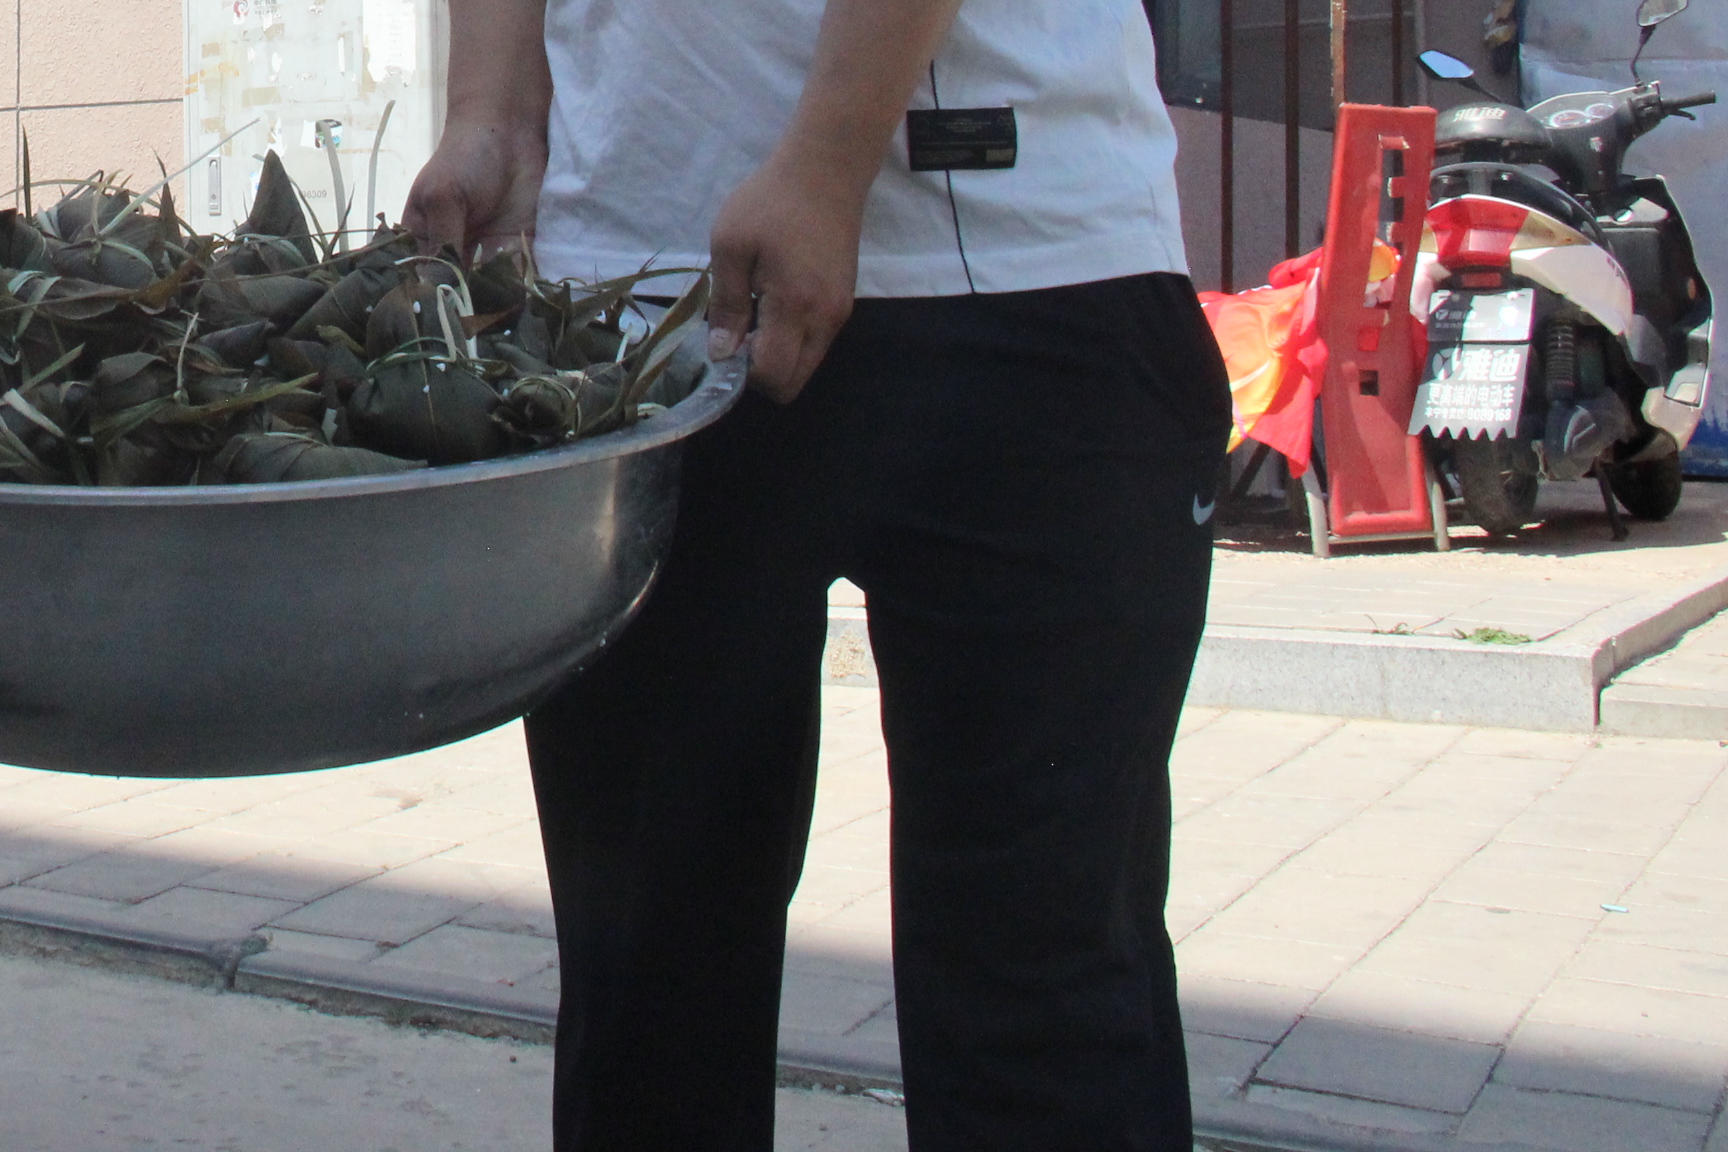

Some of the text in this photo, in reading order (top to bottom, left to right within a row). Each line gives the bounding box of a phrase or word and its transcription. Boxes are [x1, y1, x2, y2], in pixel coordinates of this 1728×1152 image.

[1458, 348, 1521, 381] 雅迪
[1426, 383, 1515, 407] 更高端的电动车
